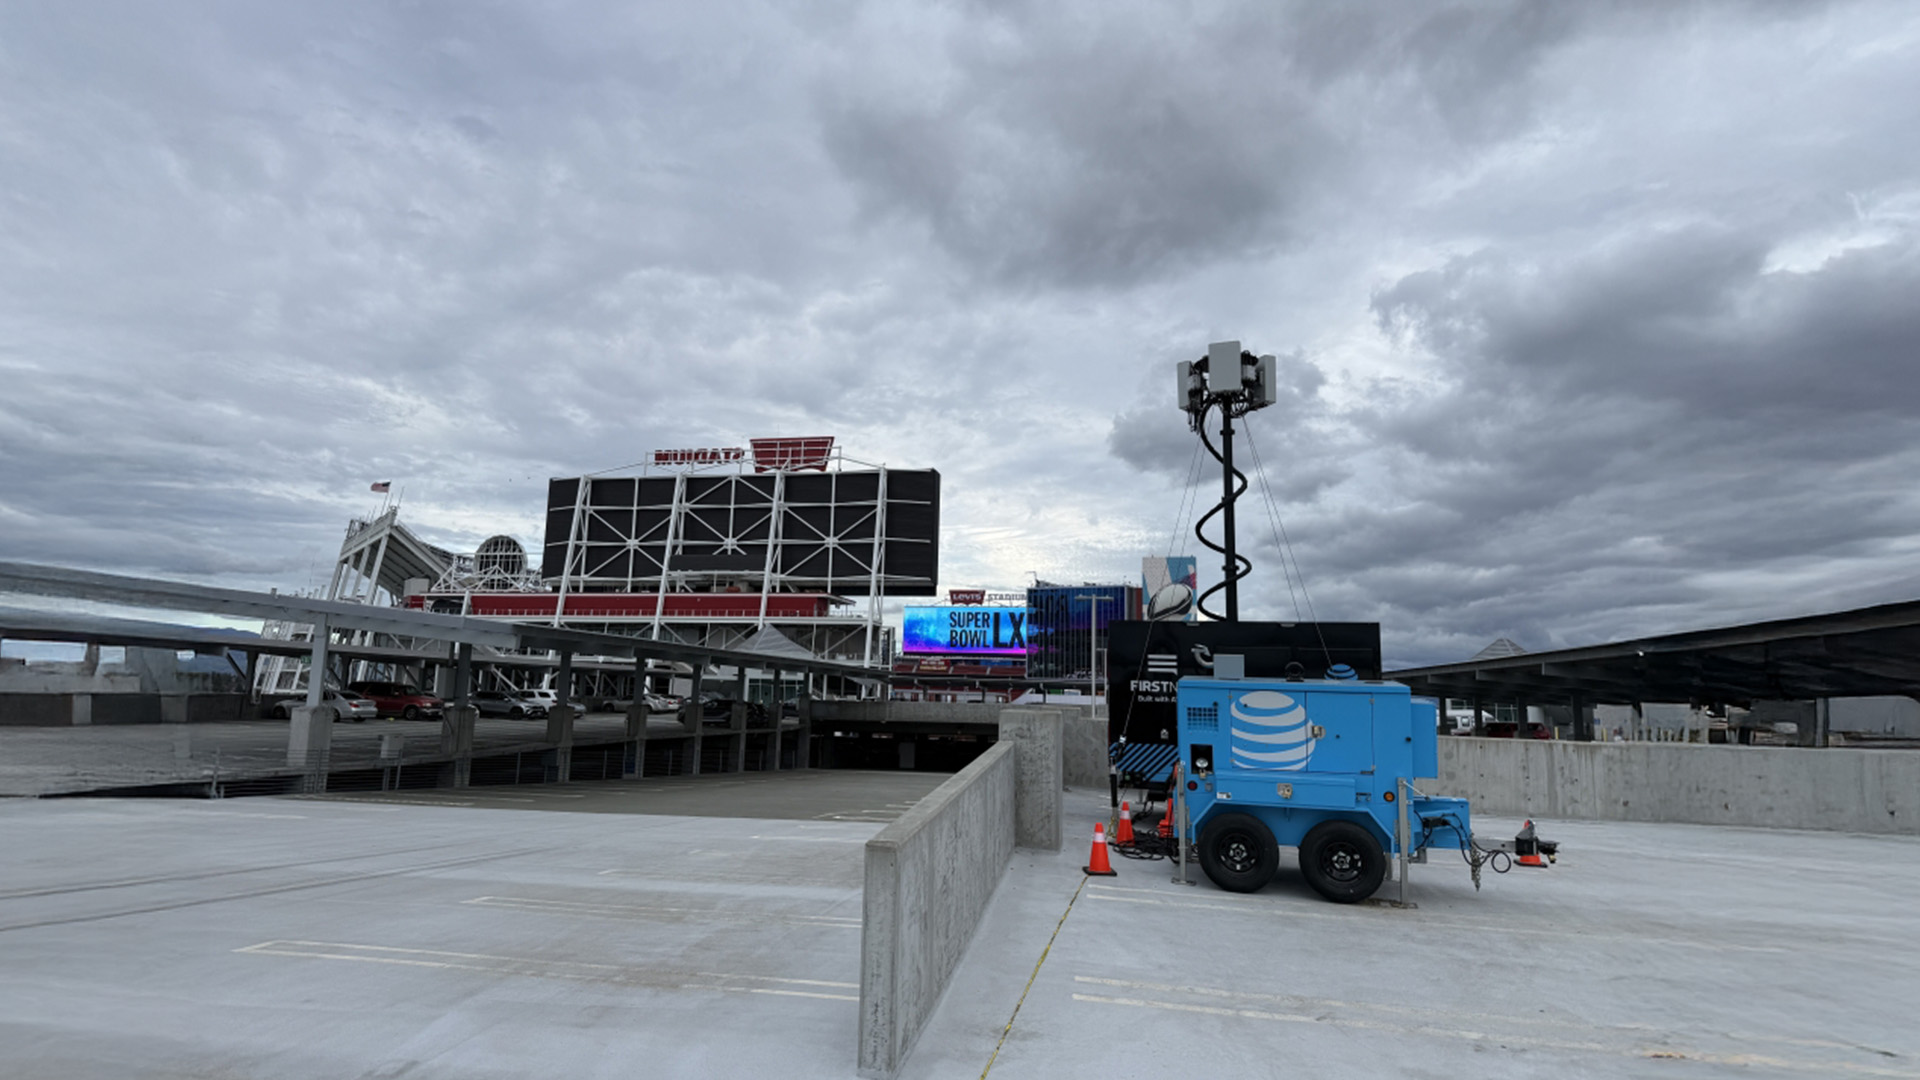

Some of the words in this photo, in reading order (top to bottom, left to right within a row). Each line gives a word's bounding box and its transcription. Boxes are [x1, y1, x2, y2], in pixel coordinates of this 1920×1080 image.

[949, 611, 990, 628] SUPER
[949, 629, 990, 648] BOWL
[993, 612, 1025, 648] LX
